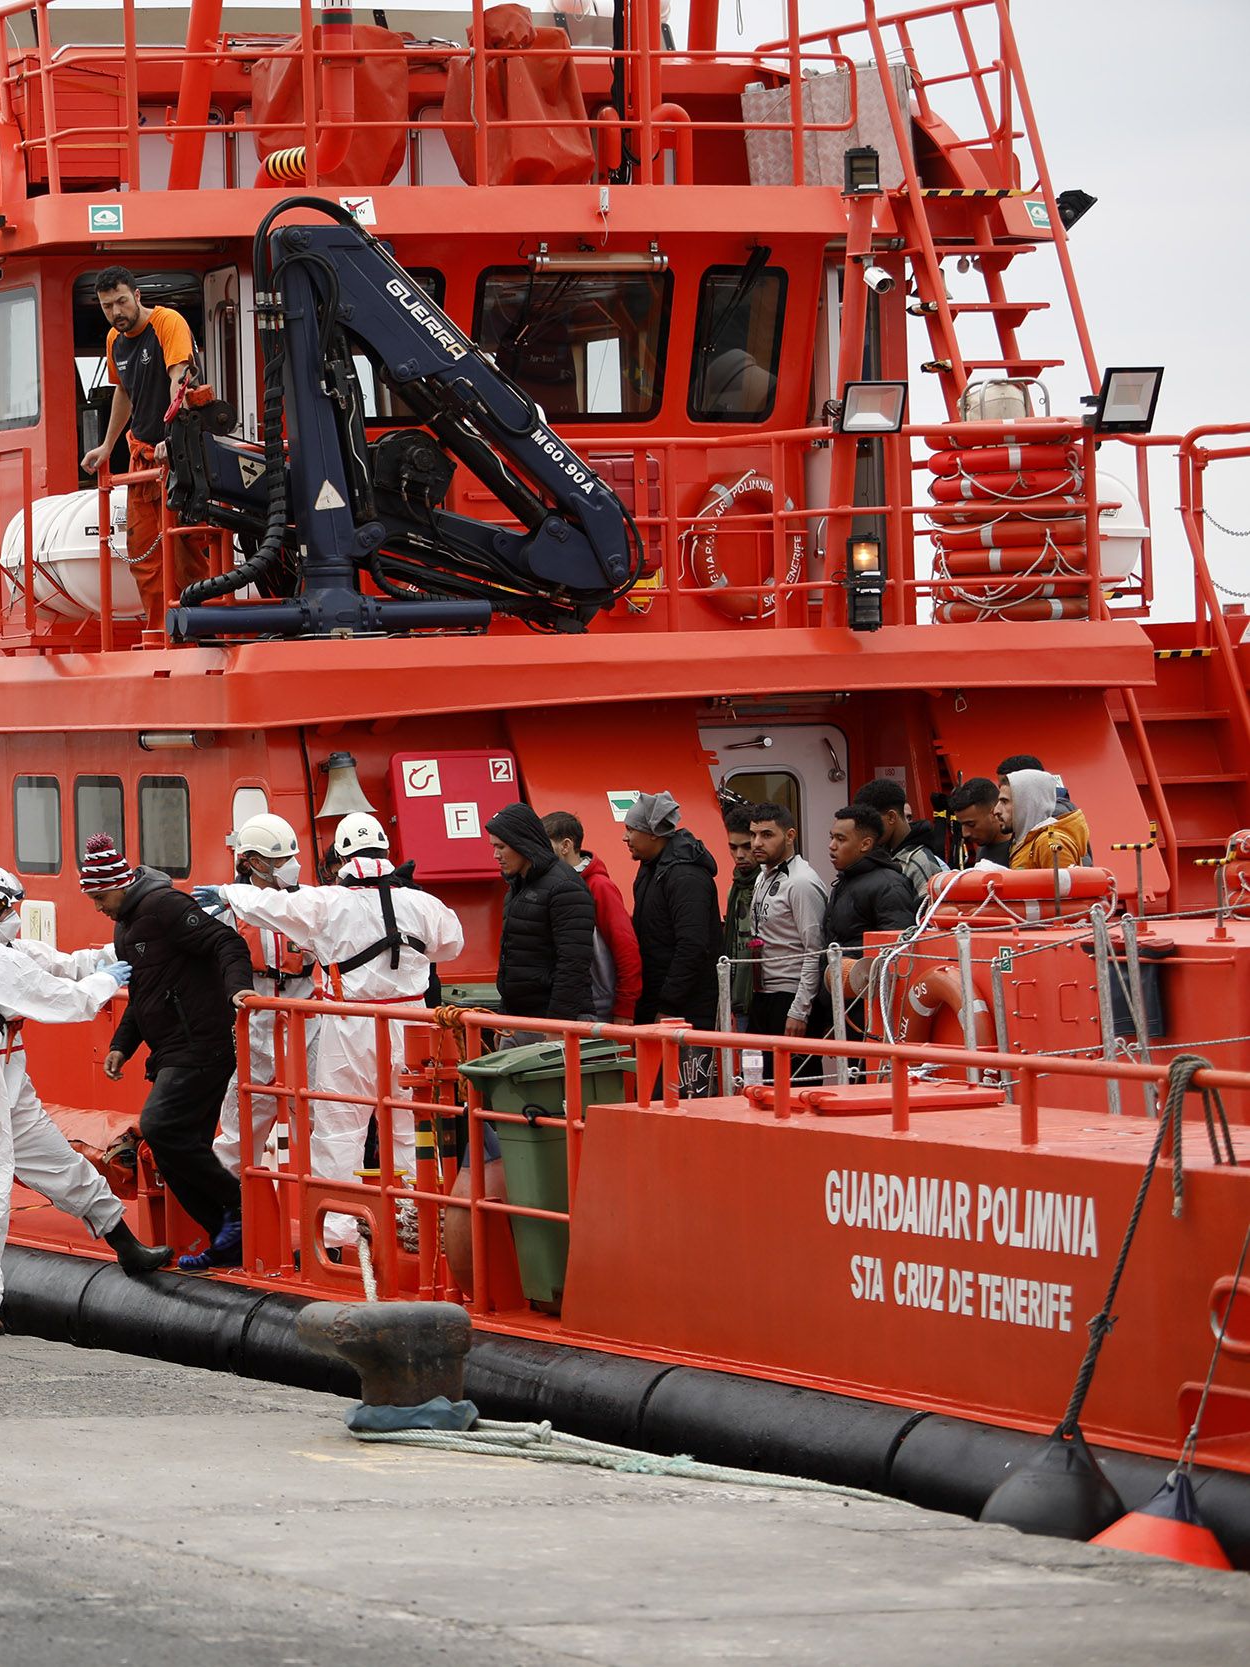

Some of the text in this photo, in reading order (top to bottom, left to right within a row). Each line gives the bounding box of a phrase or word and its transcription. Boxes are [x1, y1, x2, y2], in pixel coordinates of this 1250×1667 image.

[385, 278, 468, 361] GUERRA
[530, 428, 595, 495] M60.90A
[732, 479, 774, 498] POLIMNIA
[786, 535, 801, 584] ENERIFE
[494, 761, 510, 779] 2
[455, 810, 468, 831] F
[825, 1169, 1098, 1258] GUARDAMAR POLIMNIA
[850, 1254, 1072, 1333] STA CRUZ DE TENERIFE
